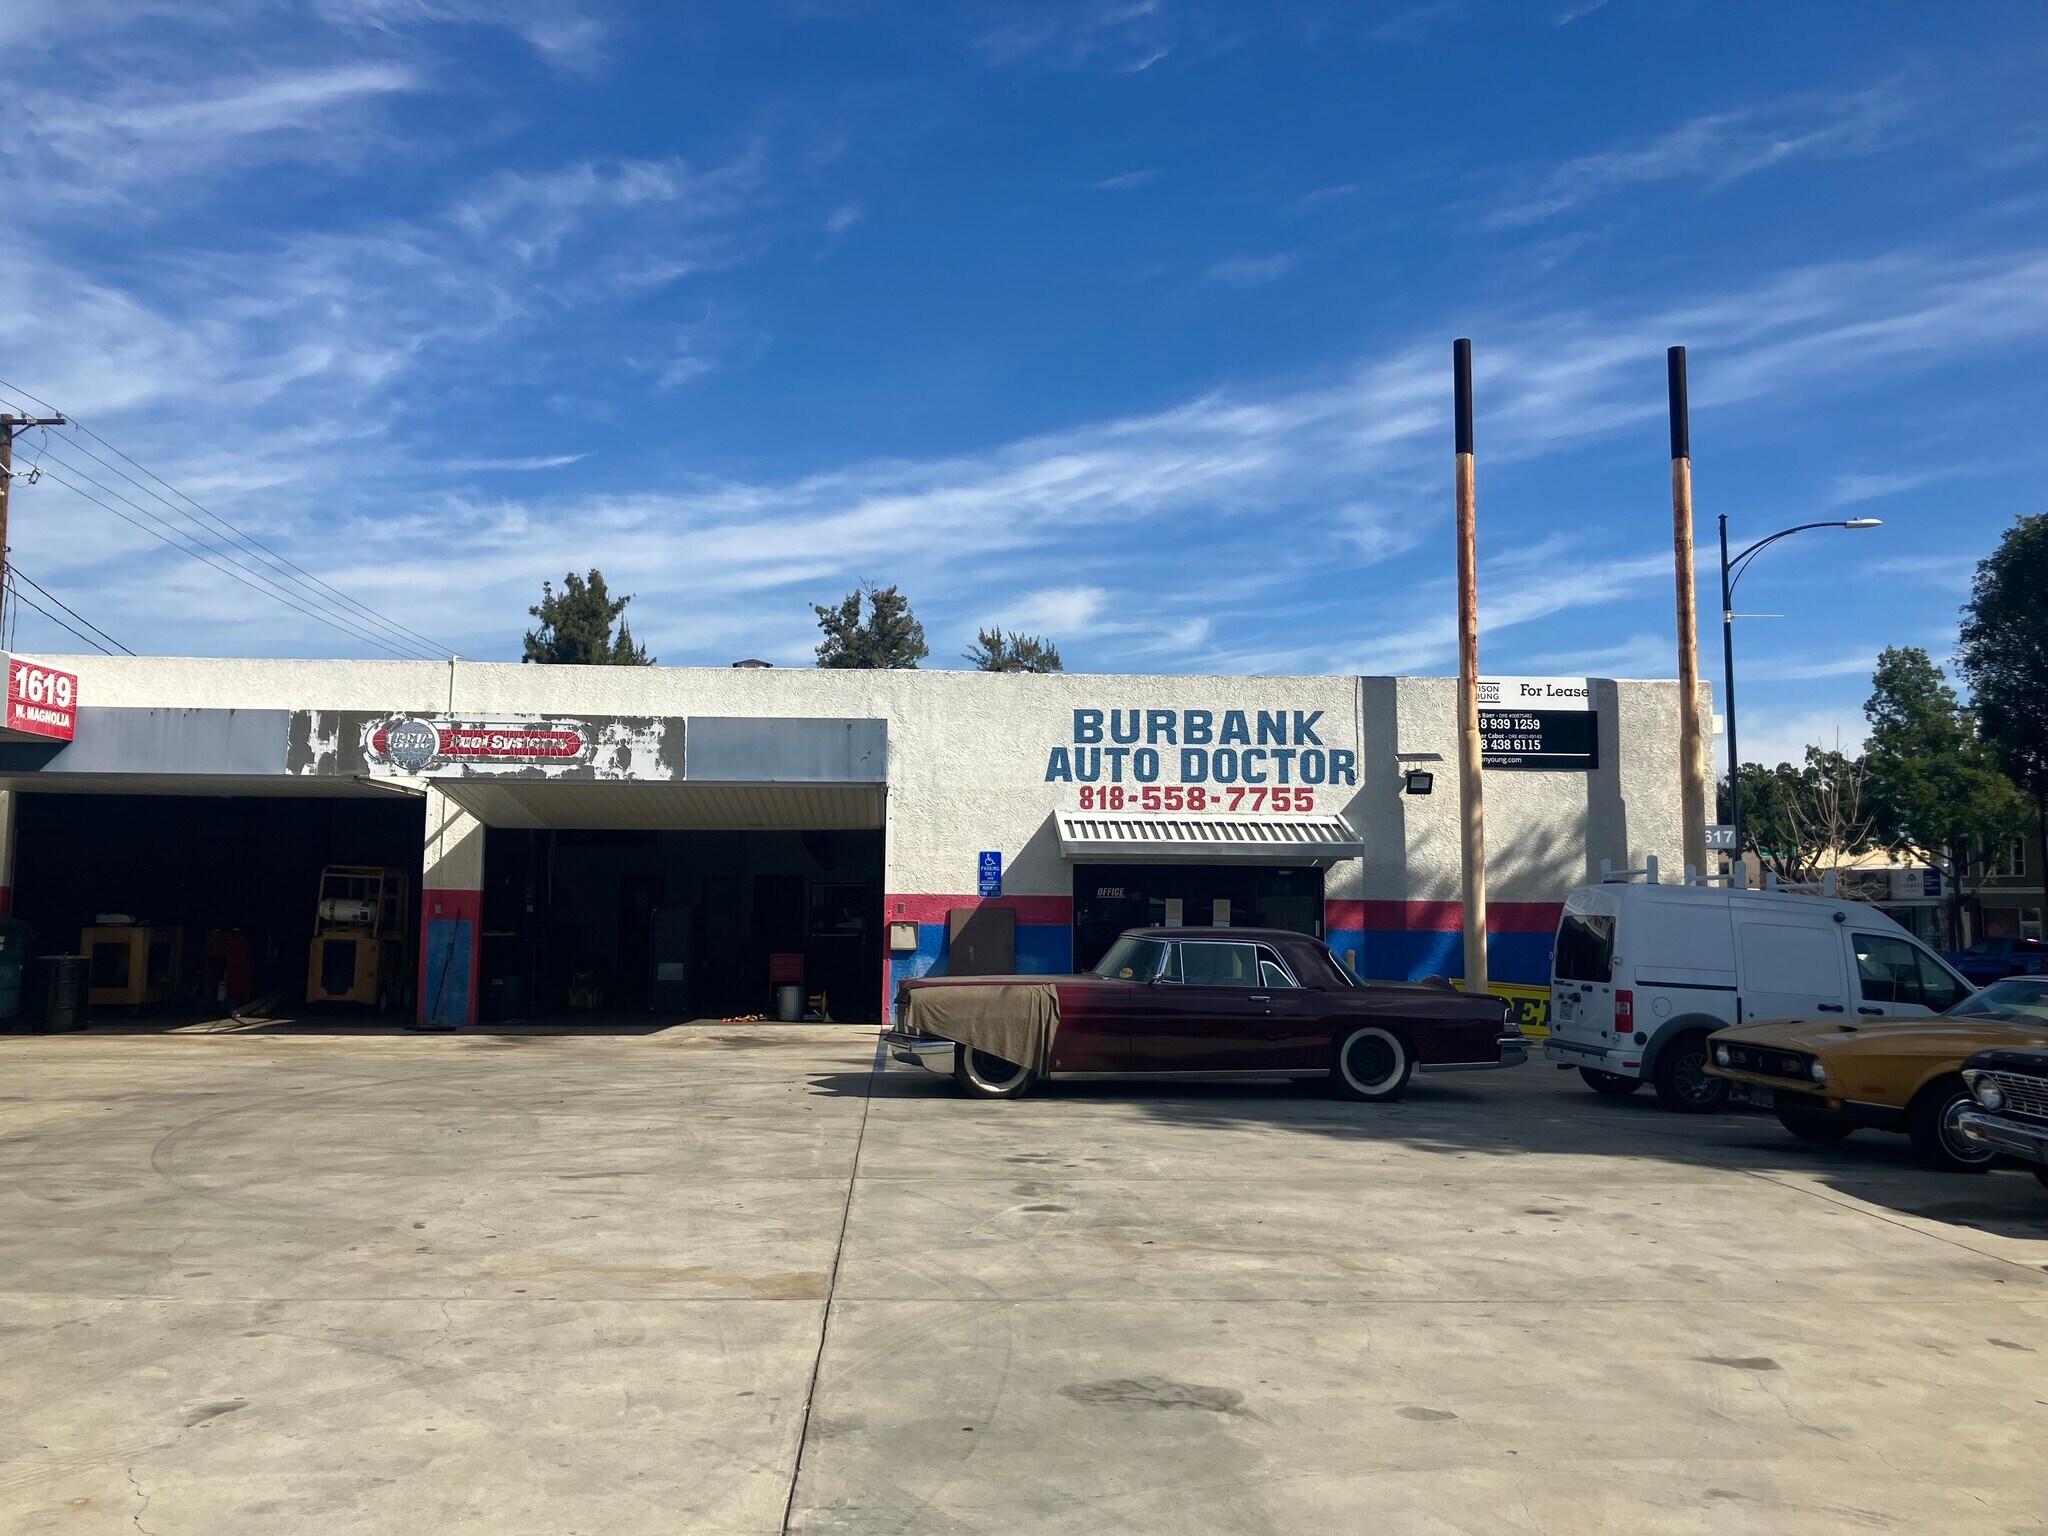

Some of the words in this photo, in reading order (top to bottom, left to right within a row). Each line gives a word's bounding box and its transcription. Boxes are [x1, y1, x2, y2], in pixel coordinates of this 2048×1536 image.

[15, 666, 71, 708] 1619
[1477, 685, 1499, 693] ISON
[1520, 684, 1542, 697] For
[1546, 684, 1590, 697] Lease
[27, 706, 70, 727] MAGNOLIA
[1073, 709, 1325, 746] BURBANK
[1490, 718, 1511, 729] 939
[1514, 719, 1540, 730] 1259
[1490, 739, 1511, 750] 438
[1513, 739, 1541, 750] 6115
[1044, 746, 1160, 783] AUTO
[1180, 748, 1357, 786] DOCTOR
[1481, 757, 1522, 765] nyoung.com
[1079, 785, 1315, 812] 818-558-7755
[1097, 887, 1125, 896] OFFICE
